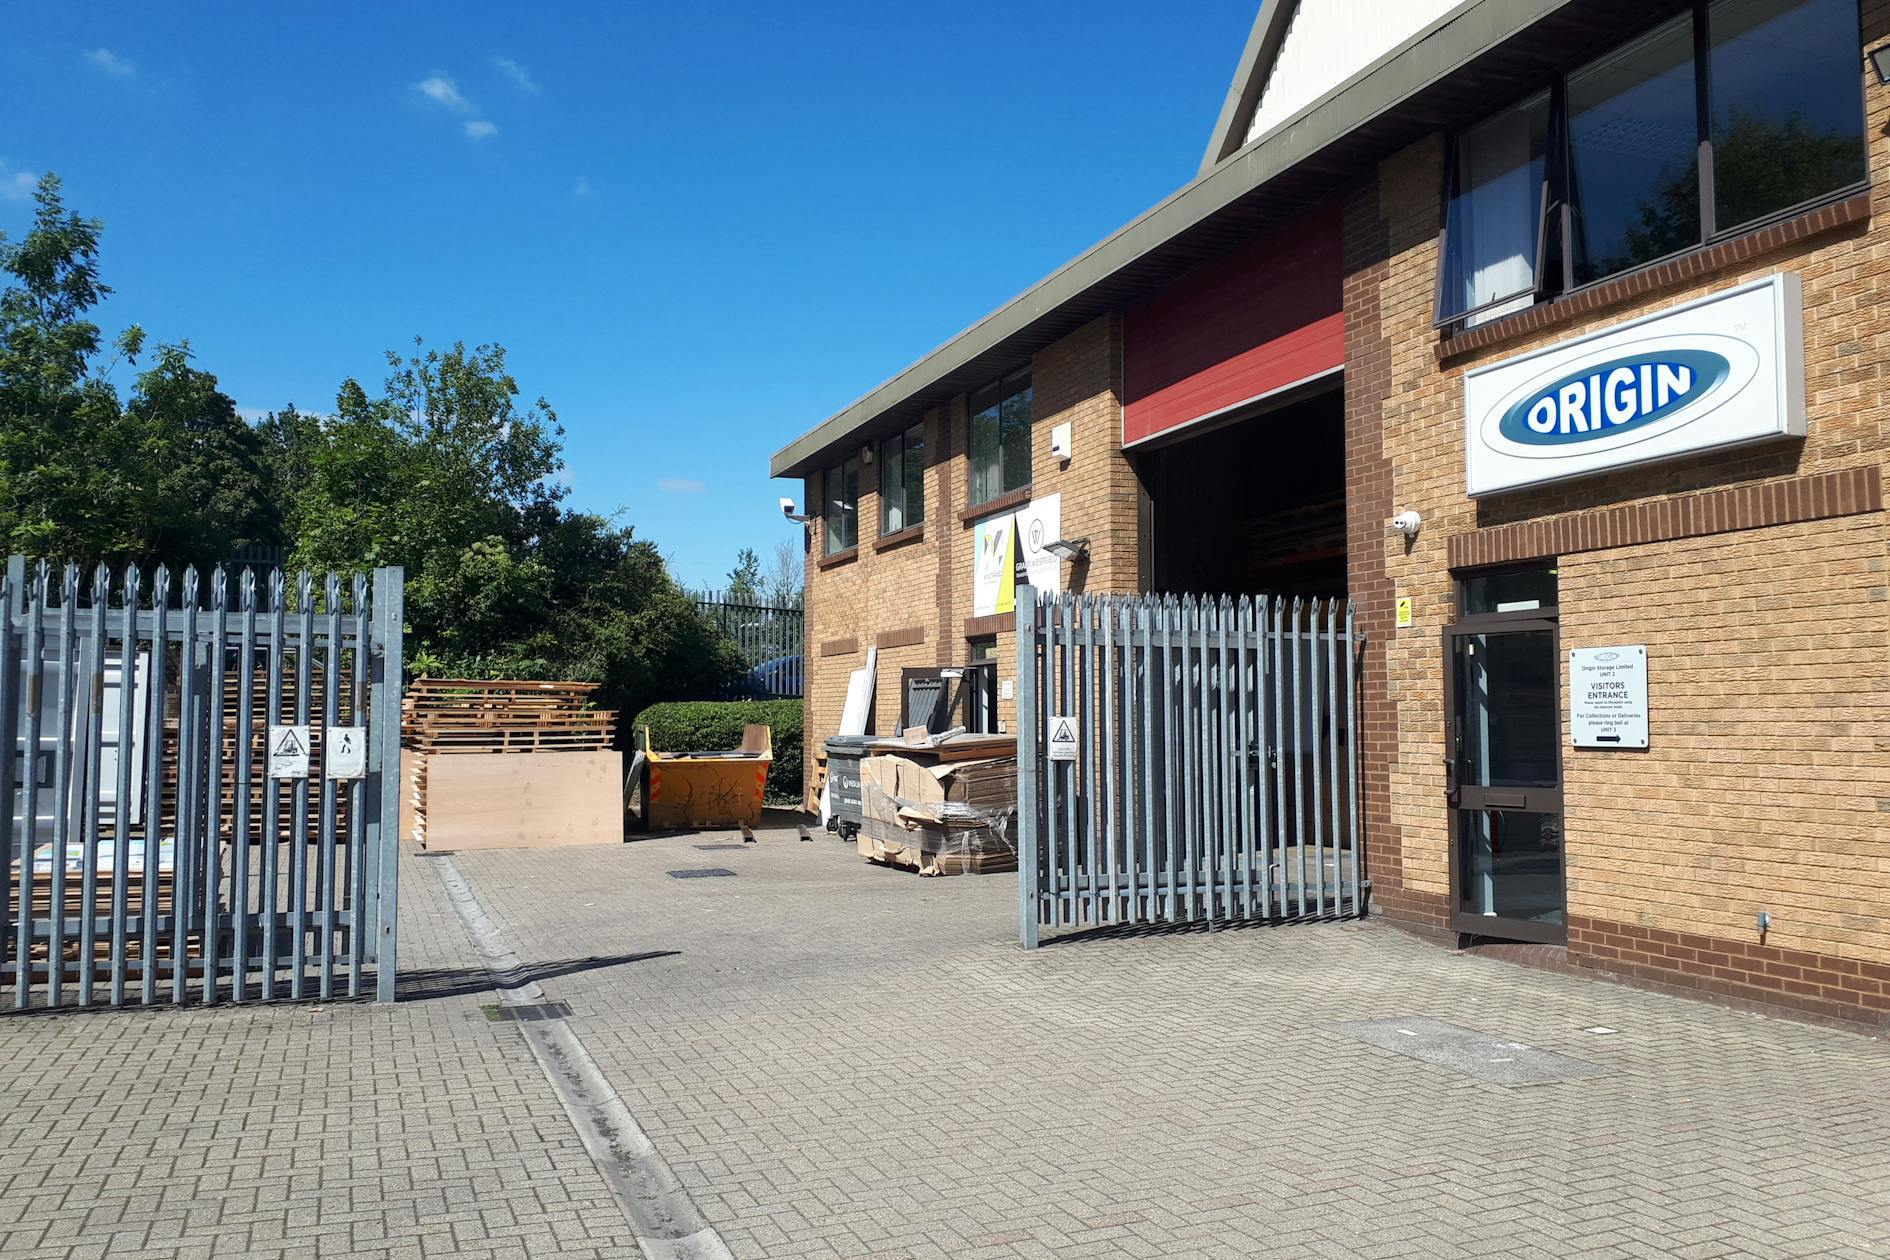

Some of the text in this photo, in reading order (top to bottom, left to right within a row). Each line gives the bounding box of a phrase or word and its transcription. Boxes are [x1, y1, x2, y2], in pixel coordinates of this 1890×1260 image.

[1527, 363, 1691, 434] ORIGIN
[1590, 682, 1625, 690] VISITORS
[1587, 691, 1629, 699] ENTRANCE
